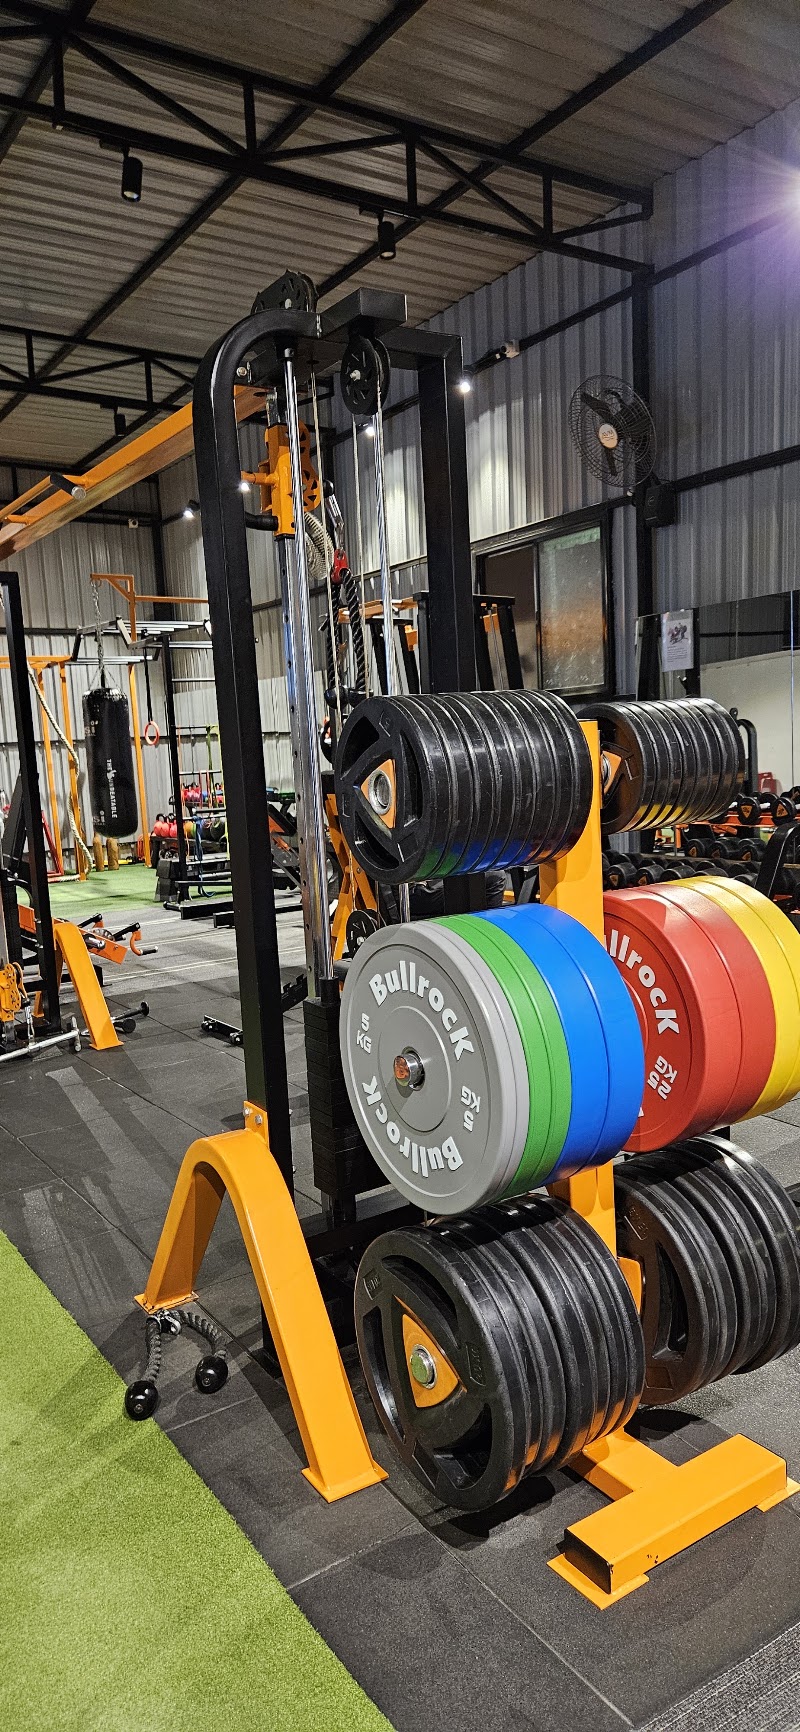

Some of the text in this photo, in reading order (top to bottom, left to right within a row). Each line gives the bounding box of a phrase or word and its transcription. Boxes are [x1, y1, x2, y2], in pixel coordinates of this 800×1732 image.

[109, 778, 118, 818] UNBEATABLE
[361, 1012, 370, 1032] 5
[356, 1029, 372, 1054] KG
[654, 1055, 678, 1084] KG
[460, 1085, 481, 1113] KG
[647, 1070, 672, 1100] 25
[463, 1110, 474, 1132] 5
